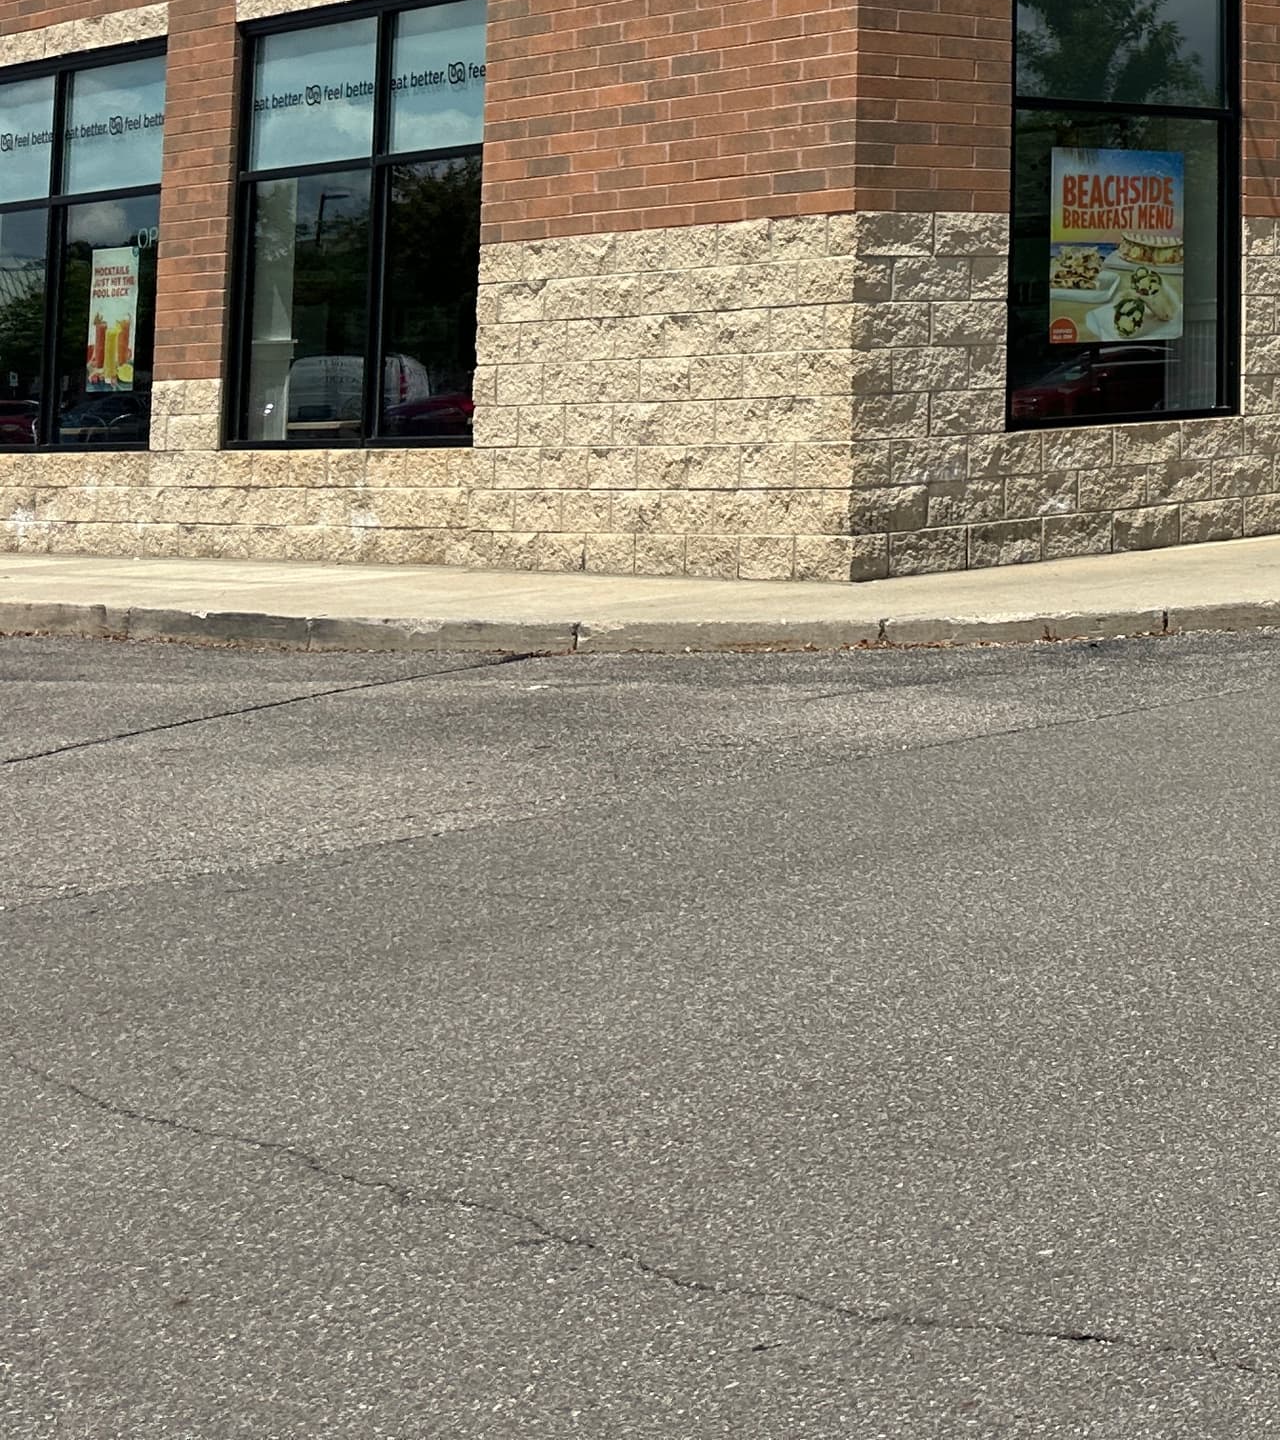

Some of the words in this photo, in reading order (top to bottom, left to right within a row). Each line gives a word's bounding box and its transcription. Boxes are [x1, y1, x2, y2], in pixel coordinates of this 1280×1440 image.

[391, 74, 408, 91] eat
[410, 70, 446, 87] better.
[468, 63, 486, 79] fee
[254, 97, 270, 111] eat
[272, 92, 304, 109] better.
[324, 83, 343, 101] feel
[346, 81, 374, 98] bette
[15, 132, 30, 148] feel
[31, 131, 54, 146] bette
[80, 122, 107, 138] better.
[125, 114, 141, 131] feel
[144, 112, 165, 128] bett
[1062, 174, 1174, 209] BEACHSIDE
[1062, 207, 1134, 229] BREAKFAST
[1137, 204, 1174, 230] MENU
[138, 226, 159, 249] OP
